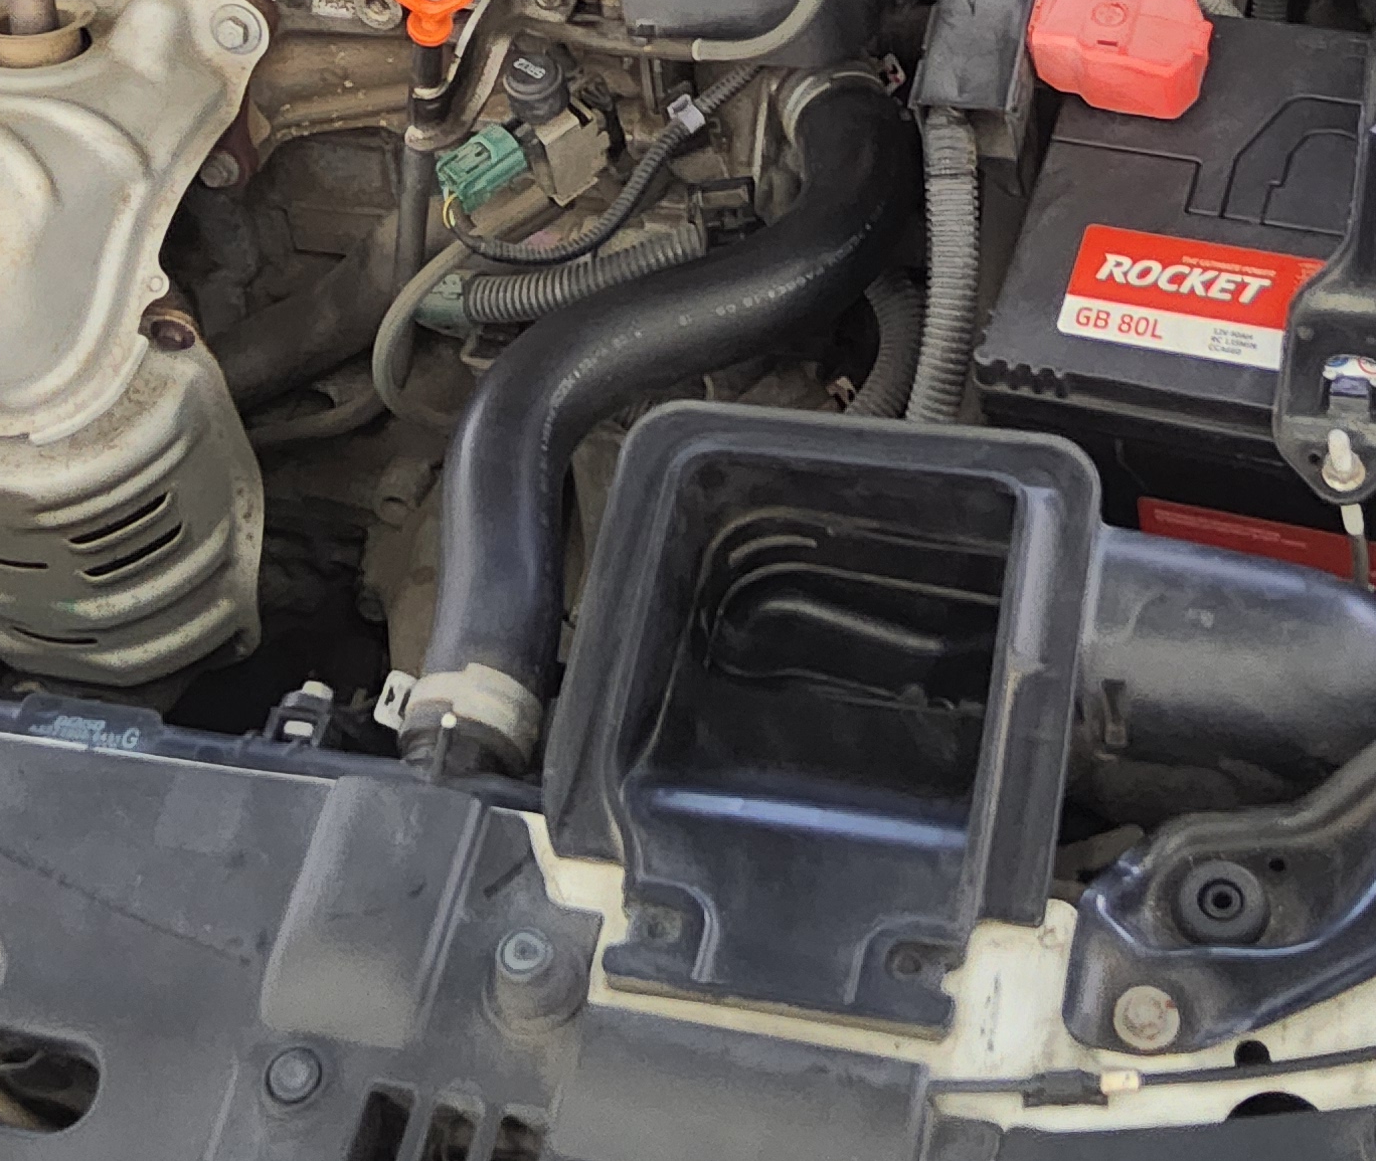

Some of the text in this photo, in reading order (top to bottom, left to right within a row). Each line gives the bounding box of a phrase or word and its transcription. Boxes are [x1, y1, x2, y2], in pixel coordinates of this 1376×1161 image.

[1095, 252, 1273, 305] ROCKET
[1075, 306, 1164, 340] GB 80L
